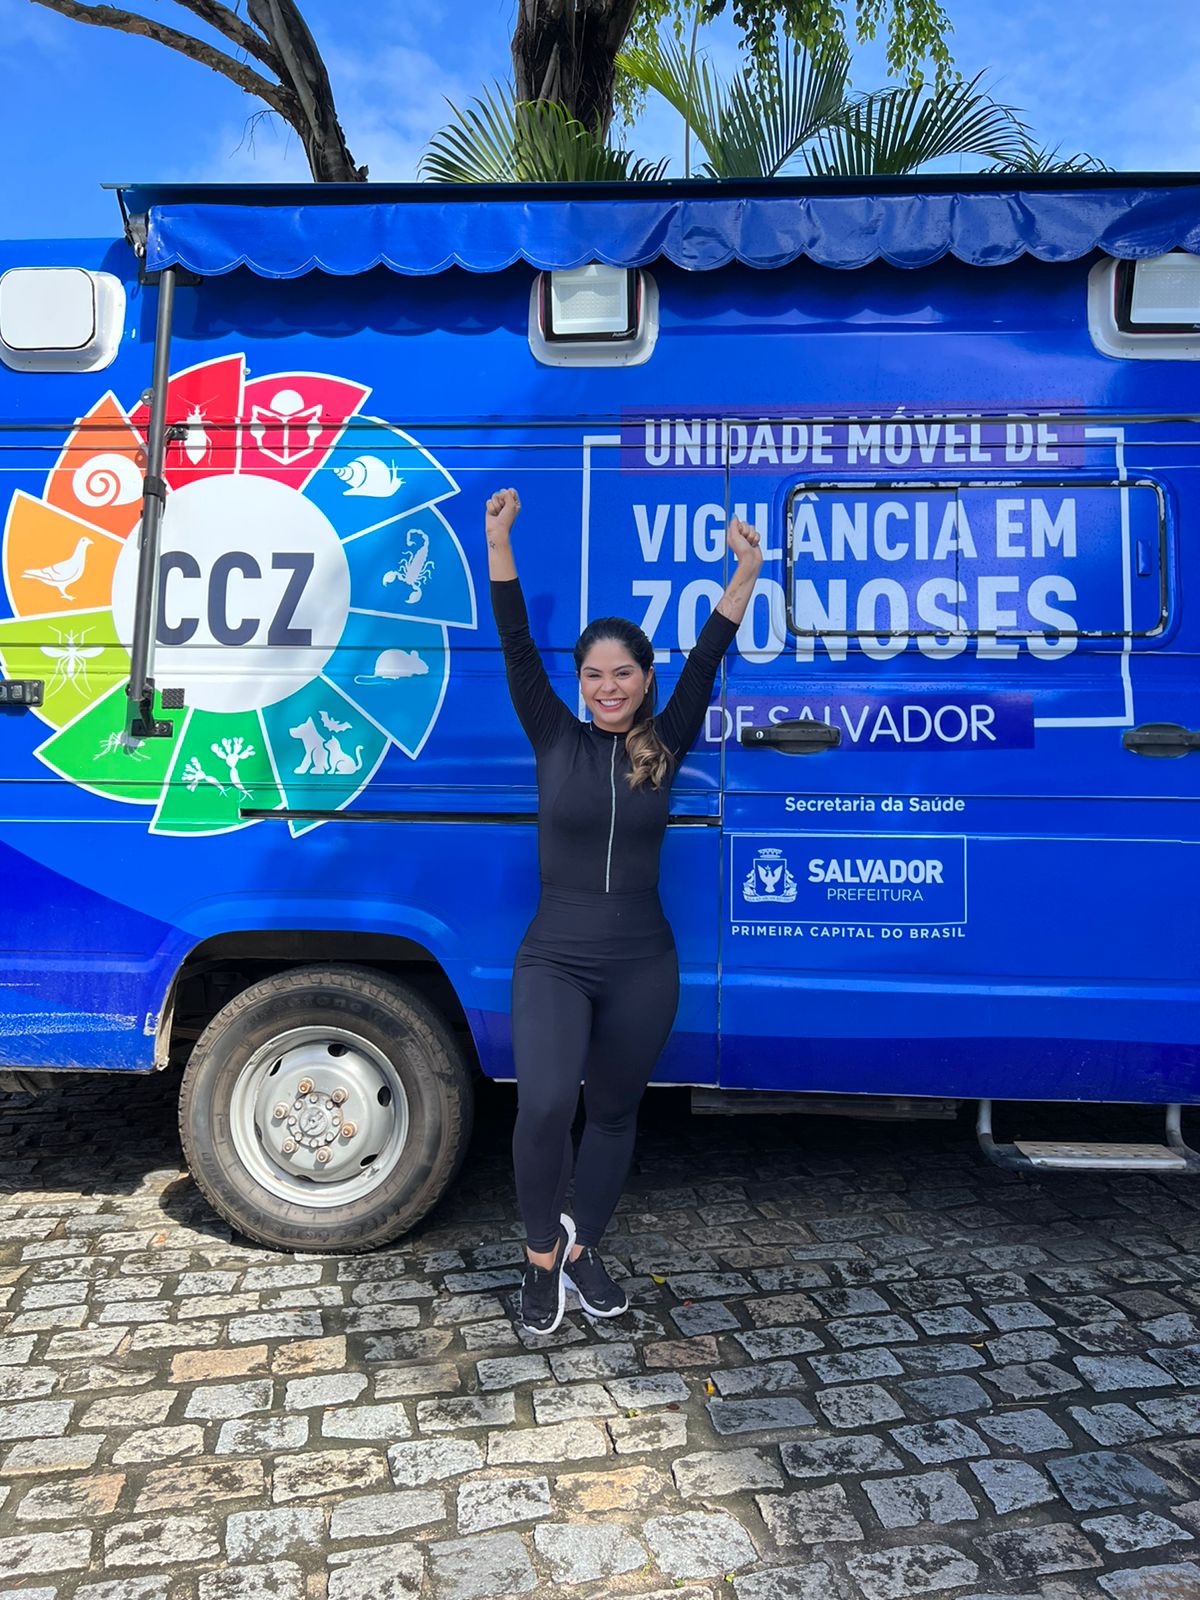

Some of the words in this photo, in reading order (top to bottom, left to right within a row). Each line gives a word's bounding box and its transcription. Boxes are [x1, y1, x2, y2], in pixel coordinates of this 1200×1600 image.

[645, 416, 833, 466] UNIDADE
[847, 406, 992, 465] MÓVEL
[1006, 412, 1061, 463] DE
[995, 497, 1077, 559] EM
[155, 550, 315, 646] CCZ
[632, 575, 1078, 664] ZOONOSES
[785, 796, 875, 812] Secretaria
[881, 796, 903, 812] da
[909, 796, 966, 812] Saúde
[807, 858, 944, 885] SALVADOR
[827, 888, 924, 902] PREFEITURA
[731, 925, 803, 937] PRIMEIRA
[810, 926, 875, 938] CAPITAL
[881, 928, 903, 939] DO
[909, 927, 966, 939] BRASIL
